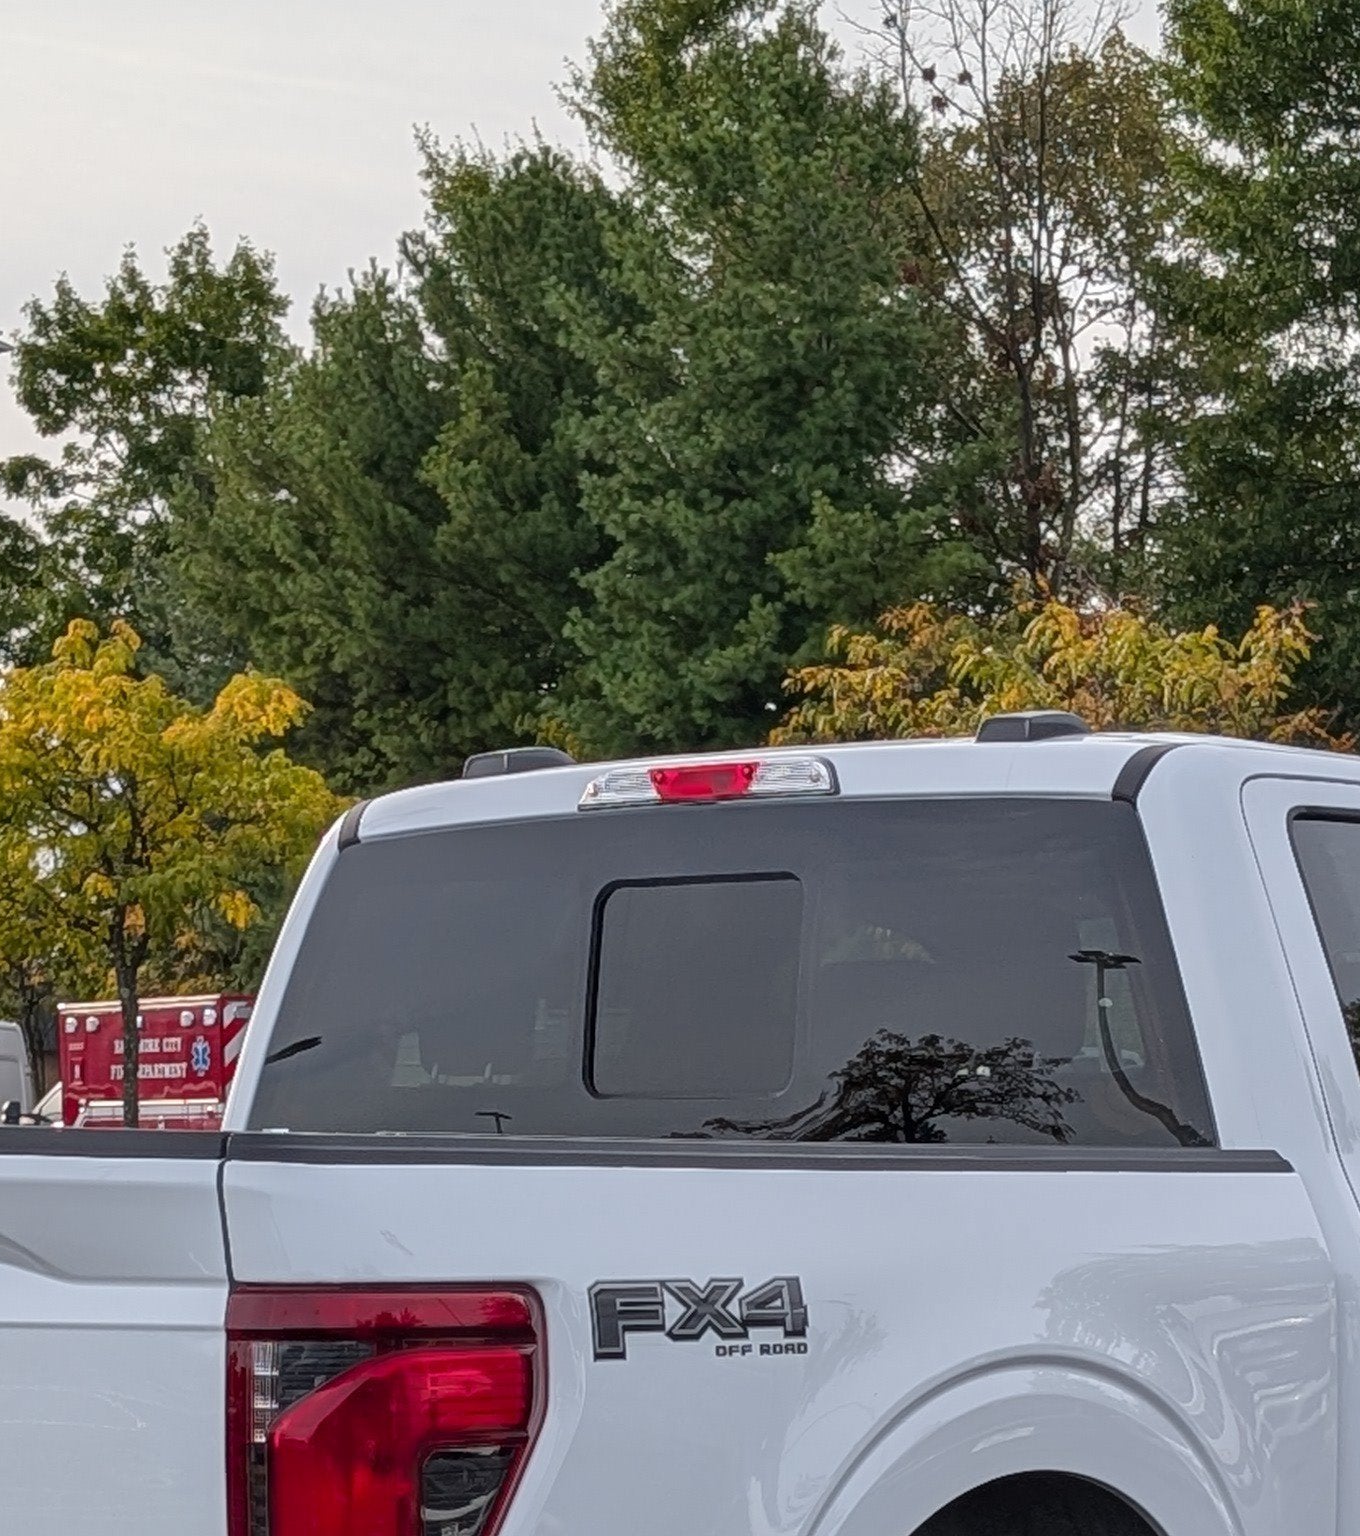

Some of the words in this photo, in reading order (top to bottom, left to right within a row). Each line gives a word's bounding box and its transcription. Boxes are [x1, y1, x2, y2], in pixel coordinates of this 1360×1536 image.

[588, 1276, 808, 1362] FX4
[715, 1344, 753, 1358] OFF
[759, 1342, 809, 1357] ROAD
